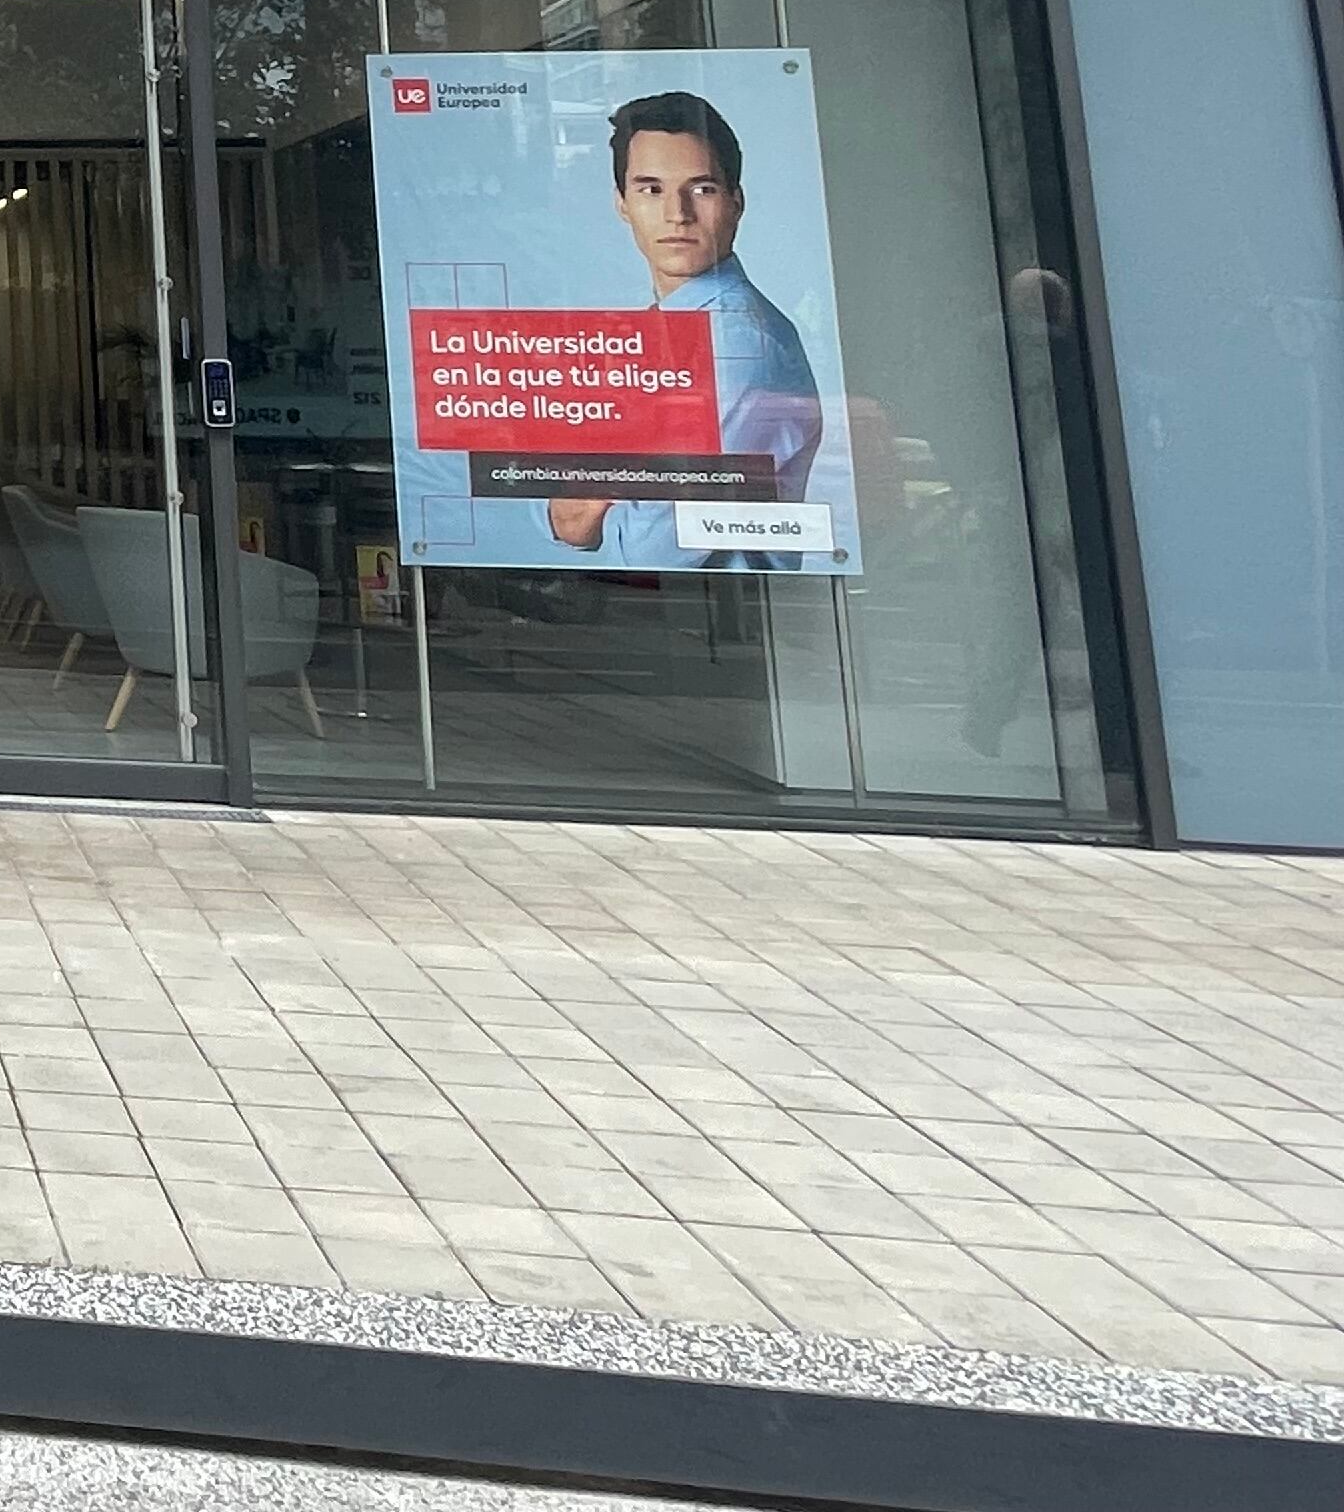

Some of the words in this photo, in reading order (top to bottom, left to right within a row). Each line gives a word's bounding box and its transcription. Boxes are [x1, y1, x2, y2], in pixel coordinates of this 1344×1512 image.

[397, 88, 427, 105] ue
[436, 81, 528, 95] Universidad
[437, 96, 501, 110] Europea
[429, 329, 466, 355] La
[472, 330, 644, 355] Universidad
[432, 366, 468, 386] en
[475, 362, 502, 387] la
[508, 368, 564, 392] que
[569, 364, 601, 387] tú
[607, 364, 693, 394] eliges
[434, 394, 527, 419] dónde
[533, 395, 622, 425] llegar.
[490, 465, 746, 485] colombia.universidadeuropea.com
[701, 518, 724, 535] Ve
[728, 517, 765, 536] más
[770, 518, 802, 536] allá
